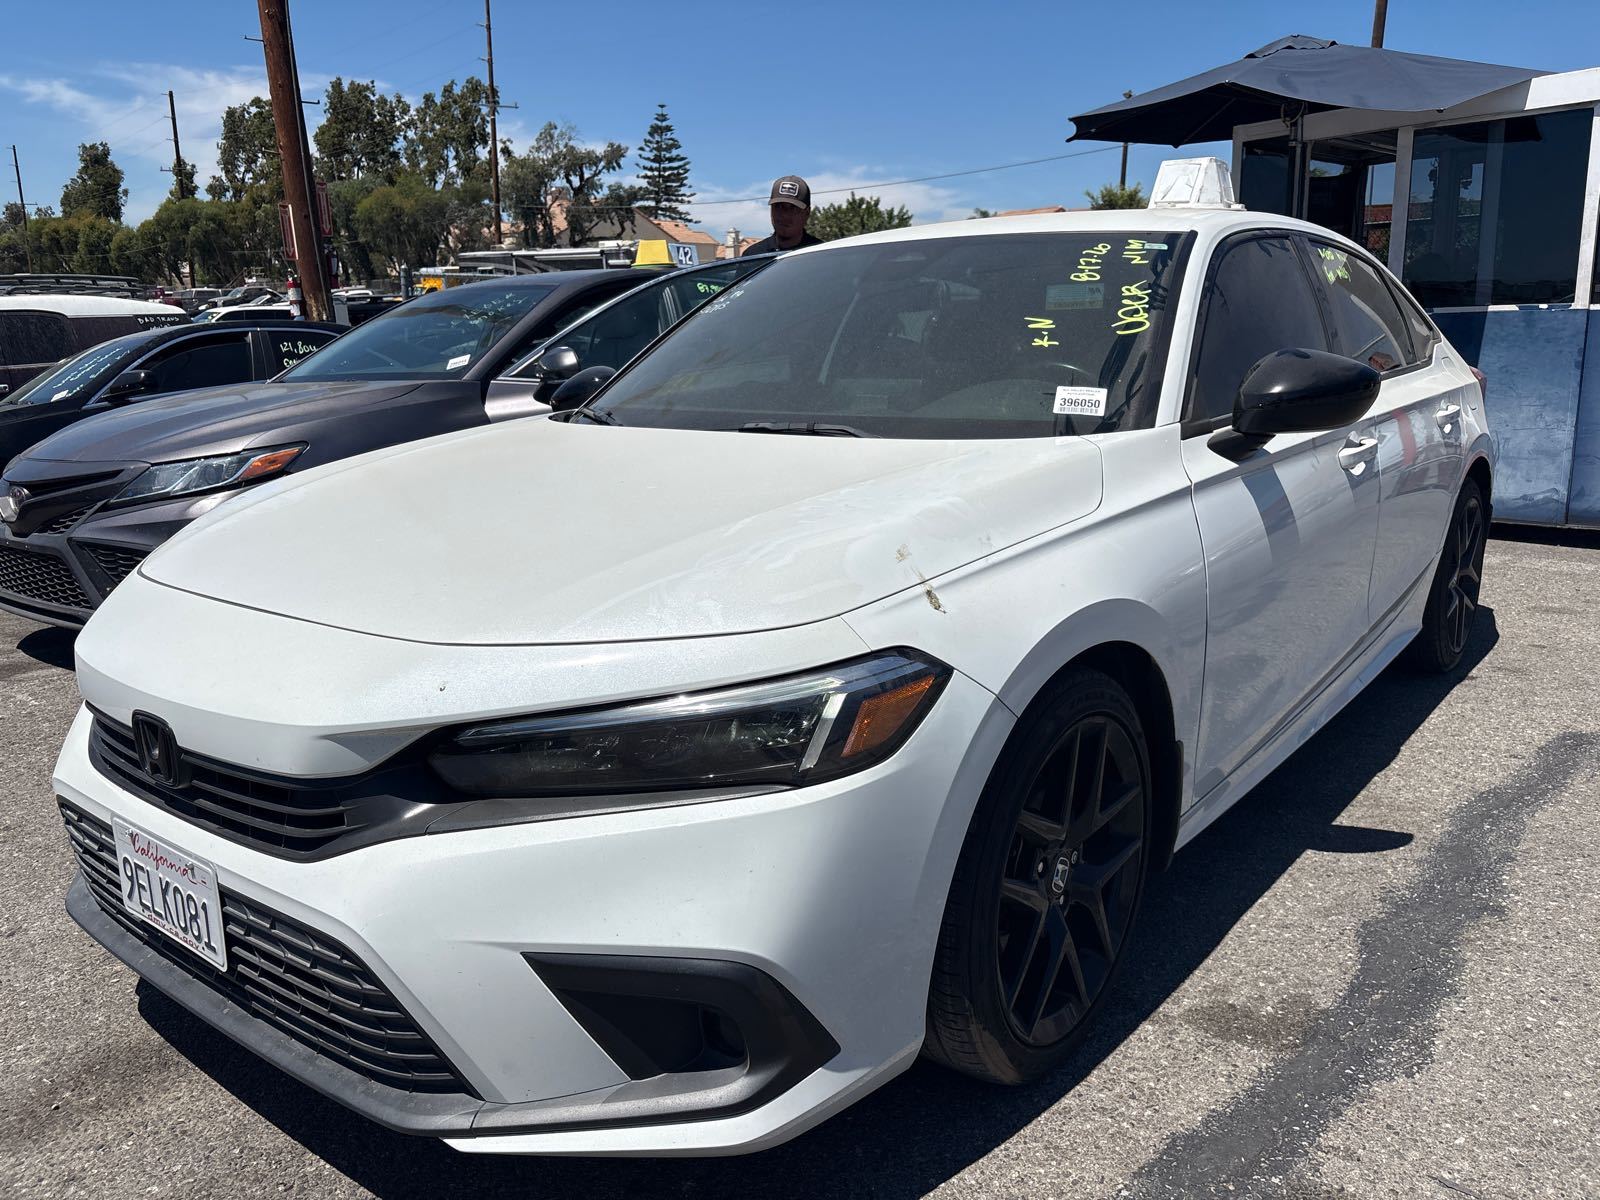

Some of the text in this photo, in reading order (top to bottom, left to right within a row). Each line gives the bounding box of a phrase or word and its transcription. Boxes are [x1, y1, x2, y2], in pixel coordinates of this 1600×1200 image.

[678, 246, 693, 265] 42
[1059, 397, 1101, 409] 396050
[131, 832, 200, 885] California
[122, 856, 218, 954] 9ELK081
